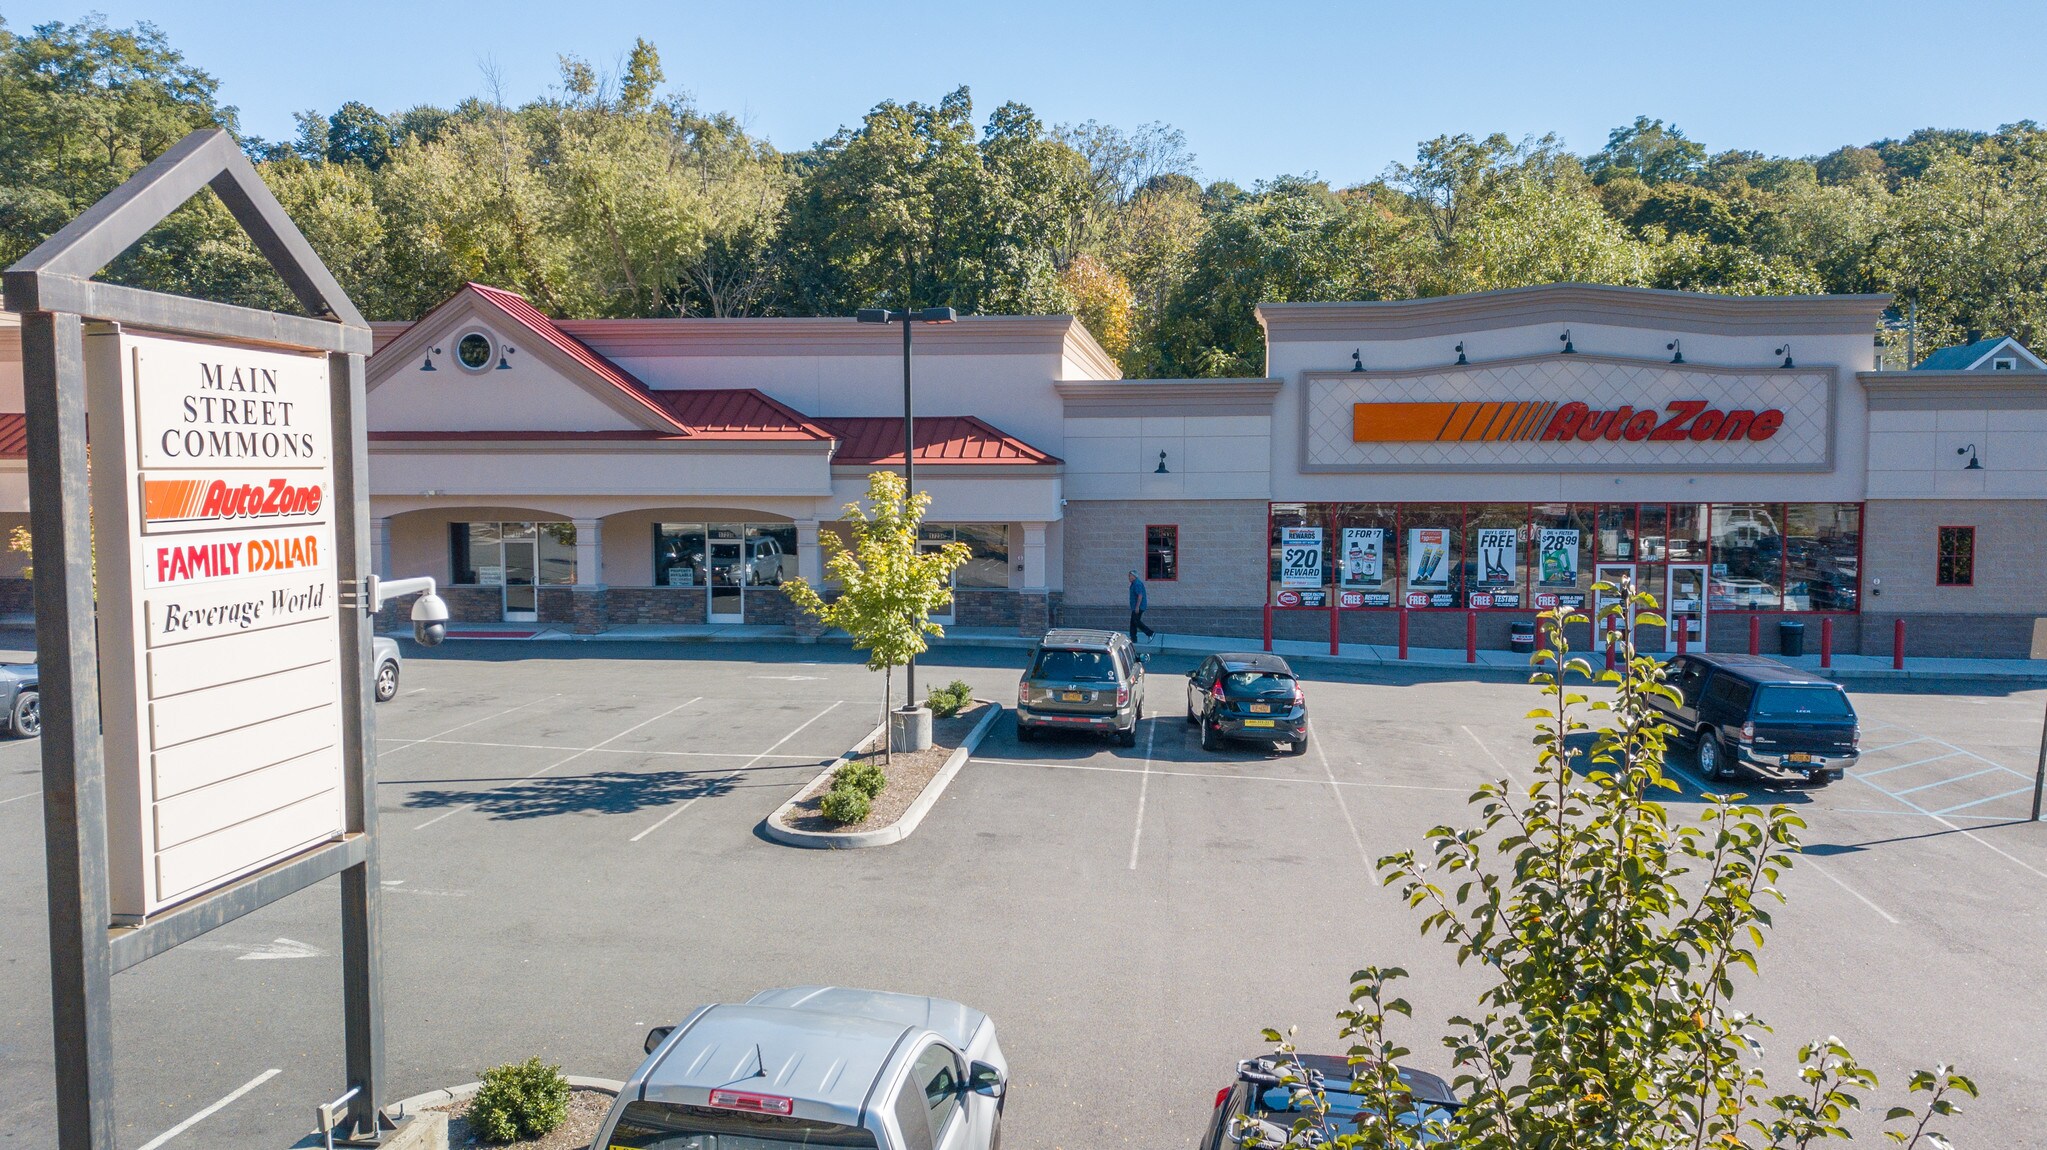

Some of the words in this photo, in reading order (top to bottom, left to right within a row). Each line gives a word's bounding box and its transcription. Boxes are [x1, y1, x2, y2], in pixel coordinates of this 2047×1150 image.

[200, 362, 277, 394] MAIN
[183, 395, 293, 427] STREET
[1540, 400, 1785, 442] AutoZone
[161, 428, 314, 458] COMMONS
[200, 478, 322, 518] AutoZone
[1347, 530, 1354, 538] 2
[1355, 530, 1372, 538] FOR
[1373, 530, 1382, 538] $7
[1480, 534, 1515, 548] FREE
[157, 542, 242, 582] FAMILY
[247, 535, 318, 573] DOLLAR
[1285, 548, 1319, 569] $20
[1283, 568, 1320, 577] REWARD
[1343, 594, 1361, 604] FREE
[1410, 595, 1427, 605] FREE
[1473, 595, 1491, 605] FREE
[1494, 595, 1519, 603] TESTING
[1538, 596, 1556, 606] FREE
[162, 598, 264, 633] Beverage
[271, 583, 325, 616] World
